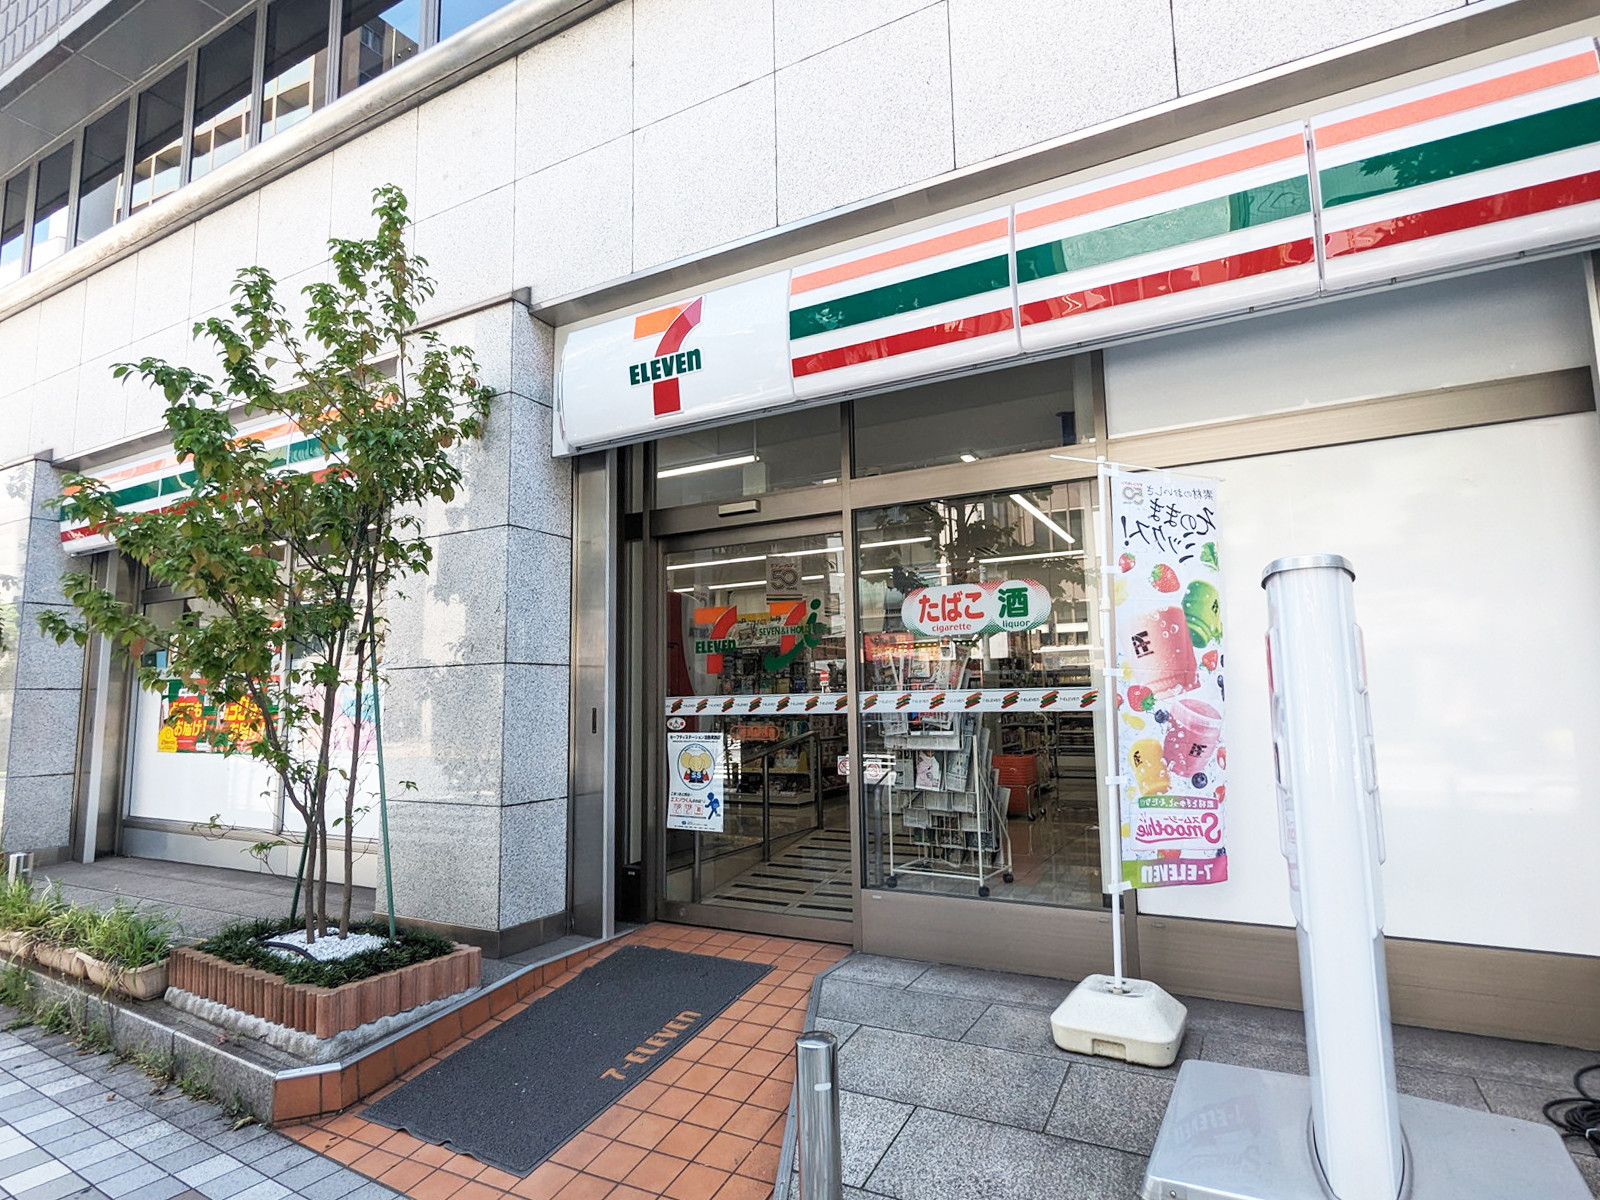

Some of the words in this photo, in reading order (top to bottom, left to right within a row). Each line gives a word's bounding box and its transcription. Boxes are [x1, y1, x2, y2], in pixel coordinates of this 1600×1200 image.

[633, 296, 703, 415] 7
[918, 590, 985, 624] たばこ
[997, 587, 1030, 619] 酒
[931, 622, 972, 634] cigarette
[1002, 618, 1031, 630] liquor
